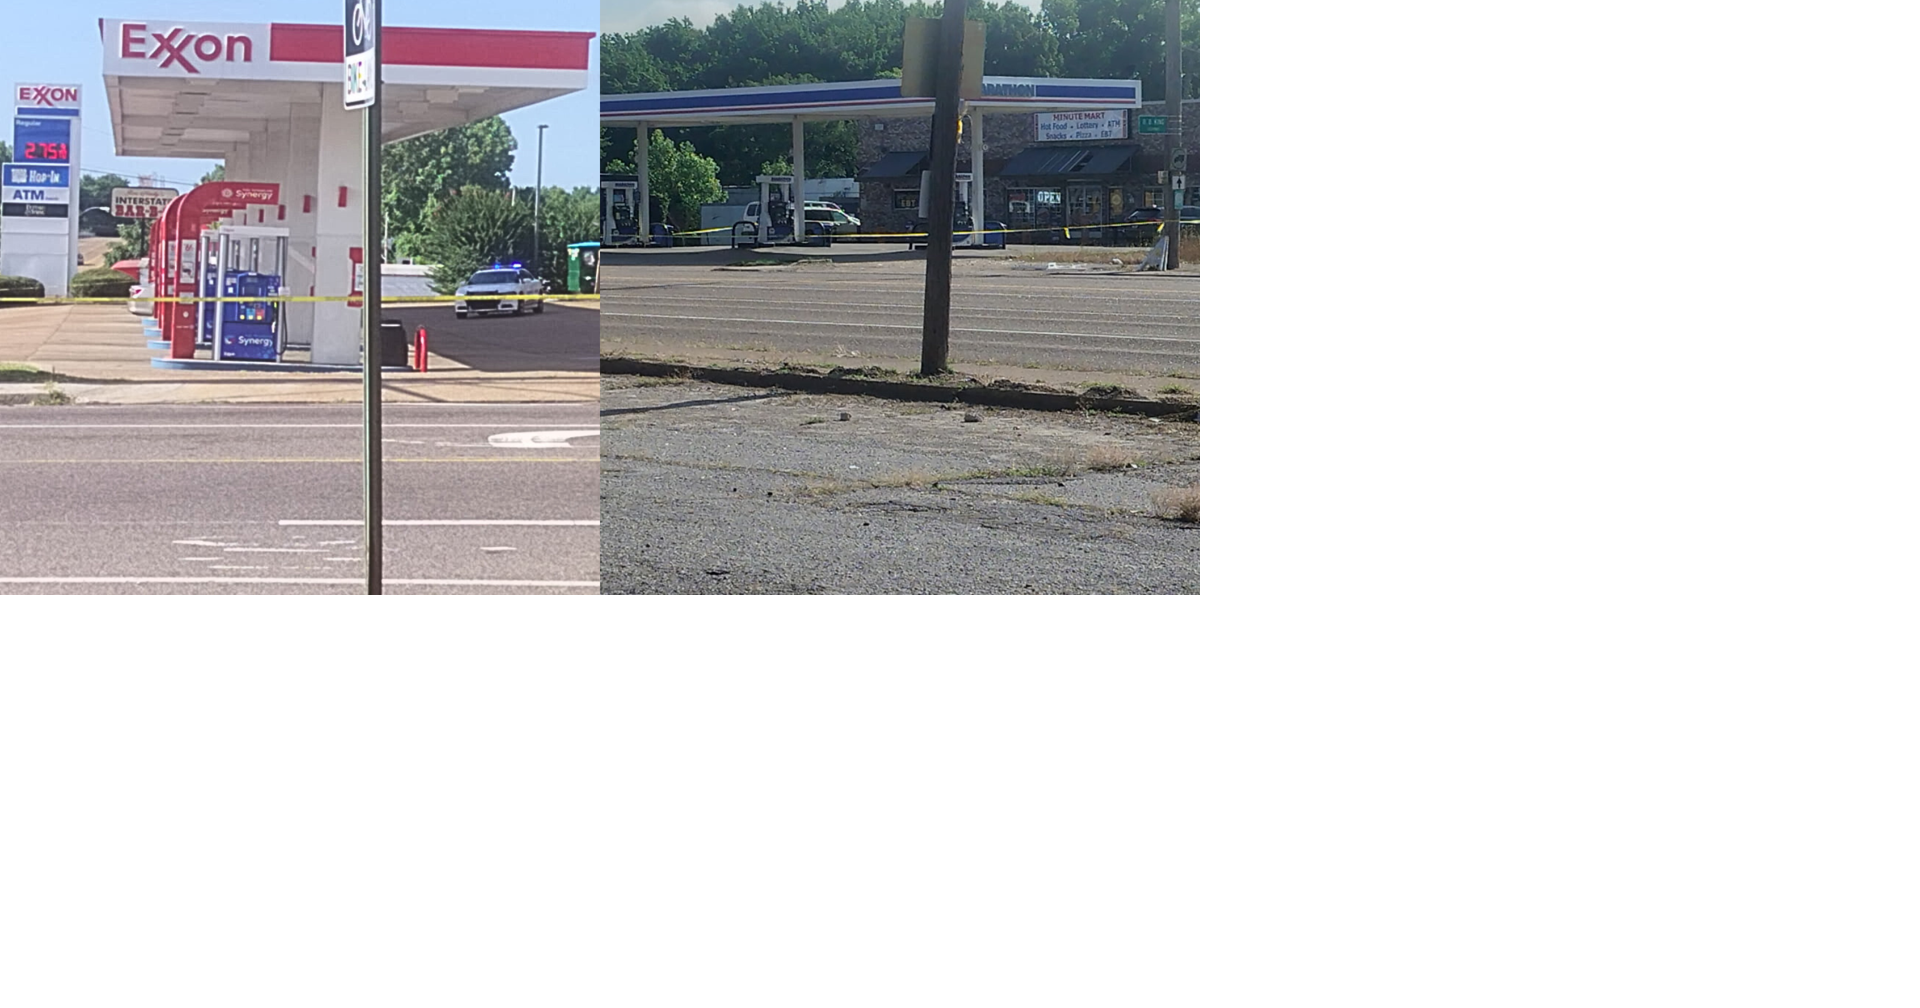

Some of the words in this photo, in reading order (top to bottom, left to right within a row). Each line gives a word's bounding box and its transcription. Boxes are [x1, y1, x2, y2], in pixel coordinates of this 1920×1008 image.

[120, 23, 252, 73] Exxon
[19, 87, 77, 106] EXXON
[982, 84, 1034, 97] ARATHON
[1053, 113, 1083, 121] MINUTE
[1084, 112, 1105, 120] MART
[1040, 123, 1052, 131] Hot
[1052, 122, 1068, 130] Food
[1076, 121, 1098, 130] Lottery
[1107, 119, 1121, 128] ATM
[1046, 132, 1067, 140] Snacks
[1075, 131, 1092, 139] Pizza
[1100, 130, 1113, 138] EBT
[13, 190, 45, 200] ATM
[235, 189, 273, 200] Synergy
[1037, 191, 1061, 204] OPEN
[238, 335, 273, 347] Synergy
